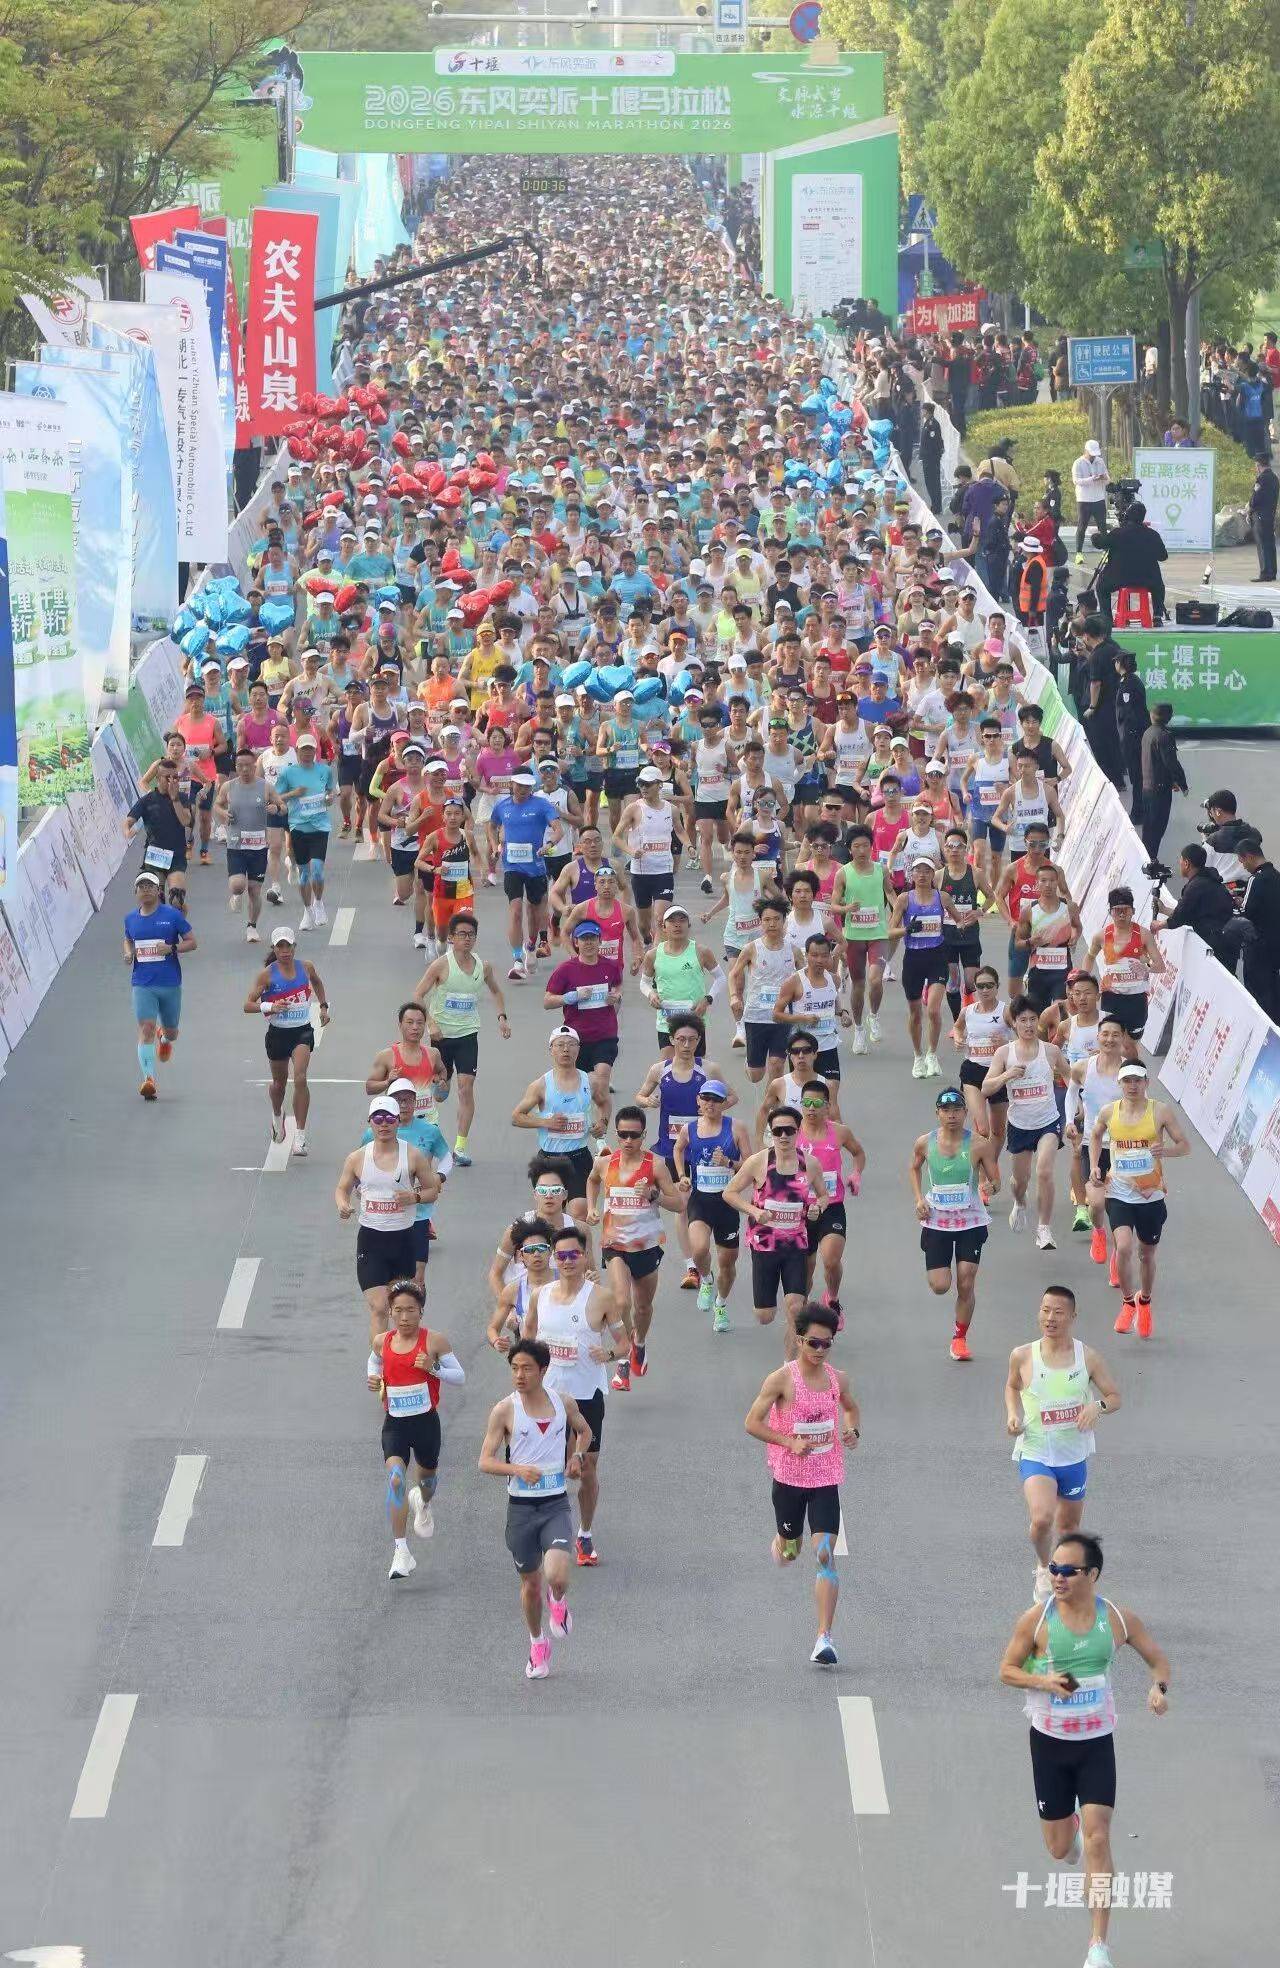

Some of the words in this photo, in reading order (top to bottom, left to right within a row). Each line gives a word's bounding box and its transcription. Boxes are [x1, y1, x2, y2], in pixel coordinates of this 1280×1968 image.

[470, 55, 500, 72] 十堰
[364, 85, 732, 116] 2026东风奕派十堰马拉松
[365, 119, 461, 130] DONGFENG
[468, 119, 510, 130] YIPAI
[518, 119, 579, 130] SHIYAN
[587, 119, 684, 130] MARATHON
[692, 119, 732, 130] 2026
[522, 180, 566, 191] 0:00:36
[260, 239, 302, 412] 农夫山泉
[189, 409, 198, 443] Special
[186, 446, 197, 500] Automobile
[1140, 463, 1209, 479] 距离终点
[1152, 482, 1199, 499] 100米
[1146, 644, 1221, 667] 十堰市
[1014, 1089, 1020, 1097] A
[1117, 1160, 1123, 1168] A
[698, 1175, 705, 1183] A
[367, 1201, 374, 1210] A
[611, 1197, 618, 1205] A
[390, 1399, 396, 1407] A
[1043, 1411, 1051, 1421] A
